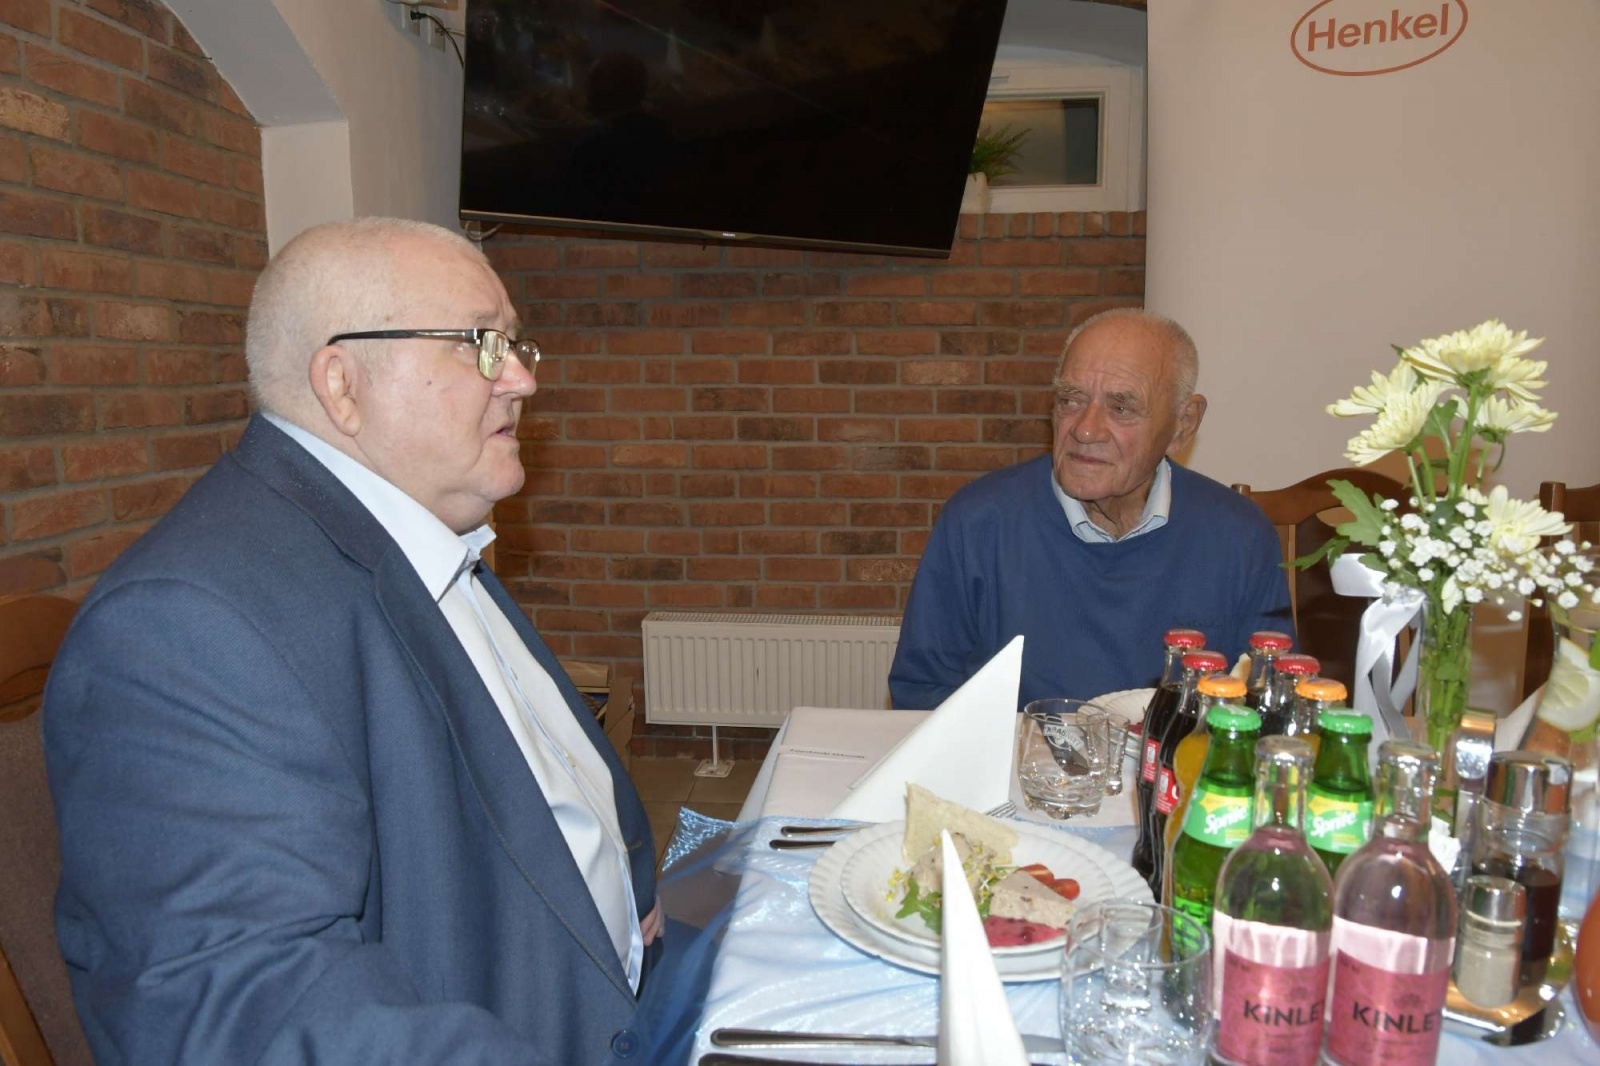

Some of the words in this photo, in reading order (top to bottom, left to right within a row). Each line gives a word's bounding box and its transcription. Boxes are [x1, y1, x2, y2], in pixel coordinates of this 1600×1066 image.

[1307, 3, 1449, 52] Henkel
[1203, 805, 1248, 835] Sprite
[1310, 810, 1358, 838] Sprite
[1243, 999, 1322, 1027] KINLE
